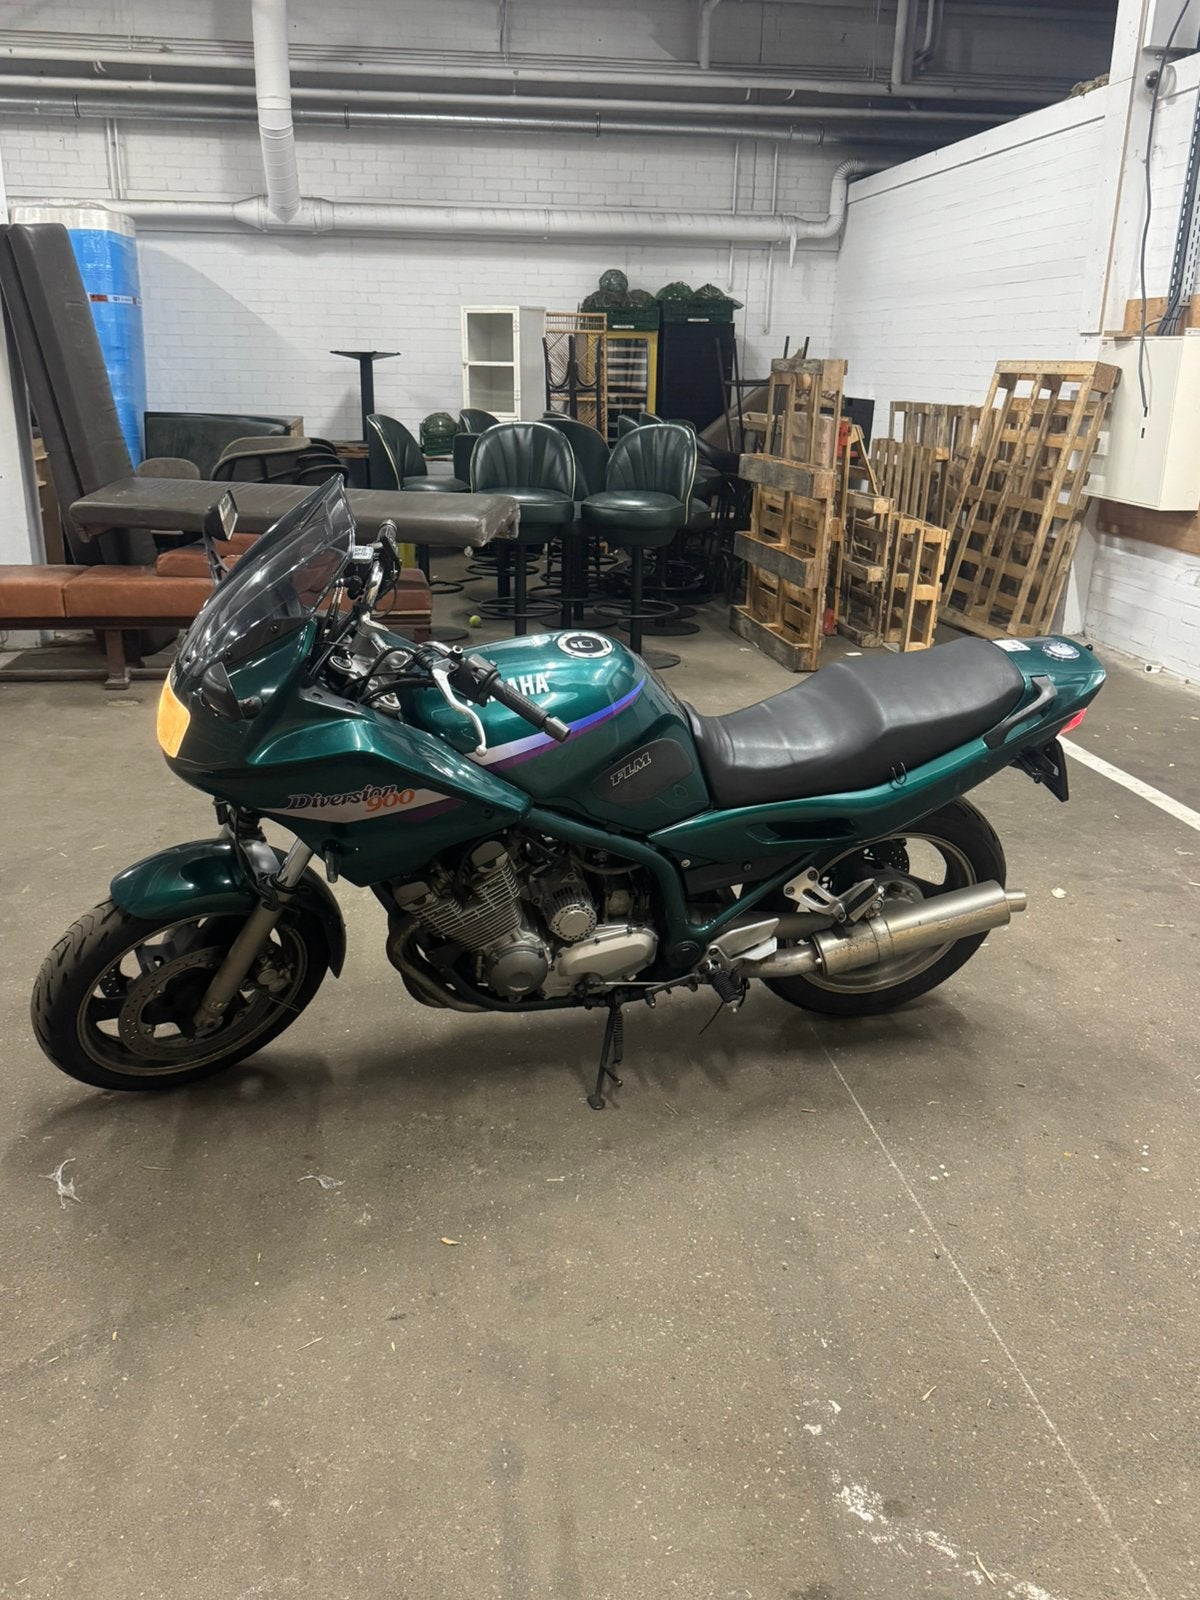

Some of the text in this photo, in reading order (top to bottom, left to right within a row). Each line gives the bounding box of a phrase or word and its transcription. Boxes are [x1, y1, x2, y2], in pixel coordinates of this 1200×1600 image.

[610, 752, 652, 786] FLM
[286, 784, 397, 809] Diversion
[365, 788, 415, 812] 900
